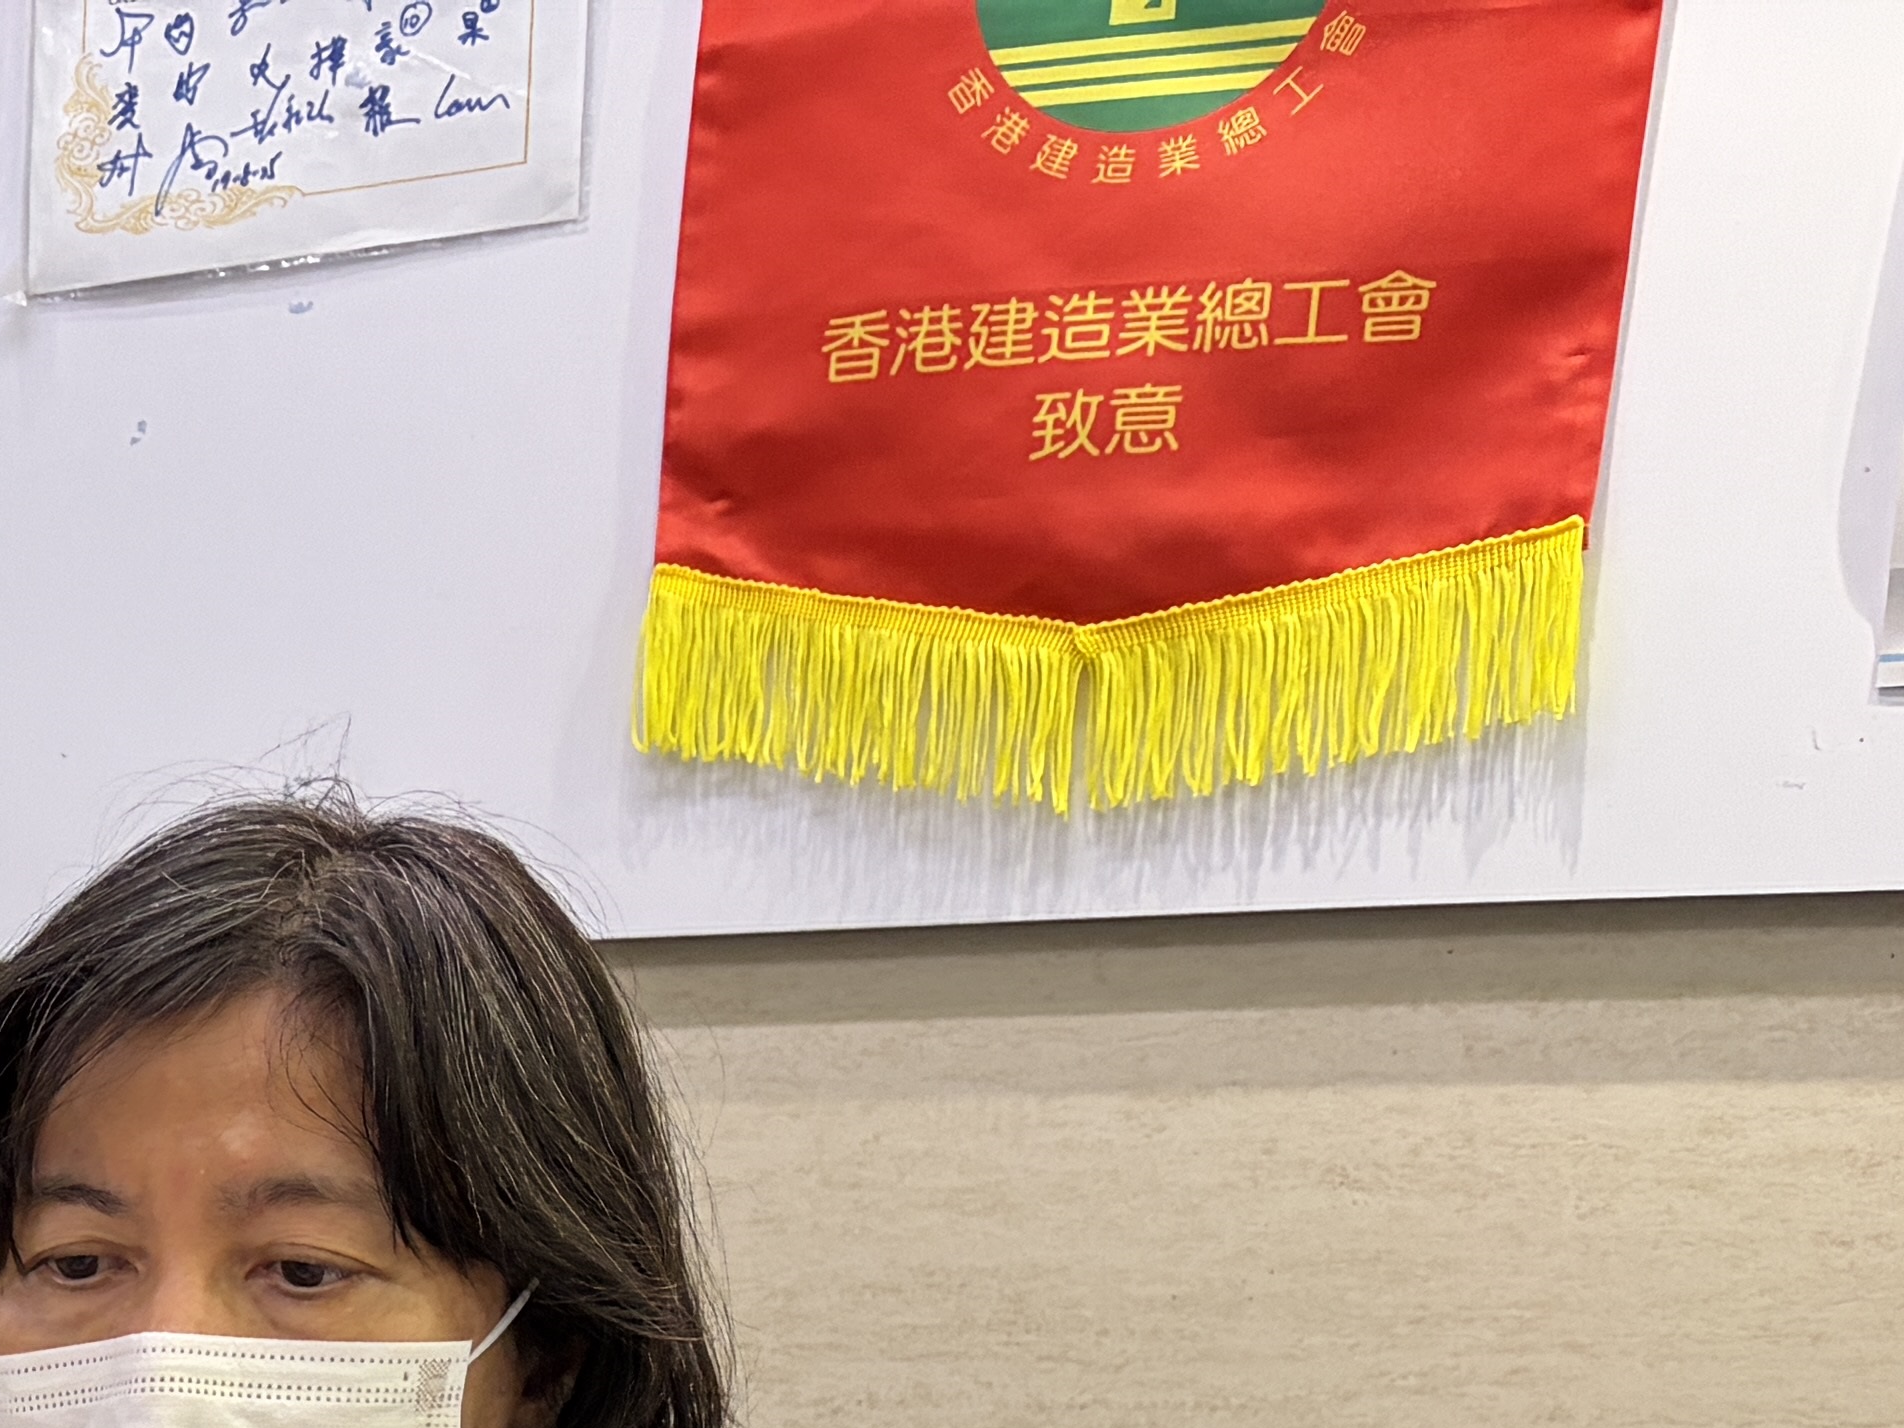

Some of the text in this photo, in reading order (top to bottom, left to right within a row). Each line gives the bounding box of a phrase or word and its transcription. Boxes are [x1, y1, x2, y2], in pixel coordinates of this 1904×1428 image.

[946, 9, 1367, 185] 香港建造業總工會
[820, 270, 1437, 384] 香港建造業總工會
[1028, 382, 1183, 463] 致意
